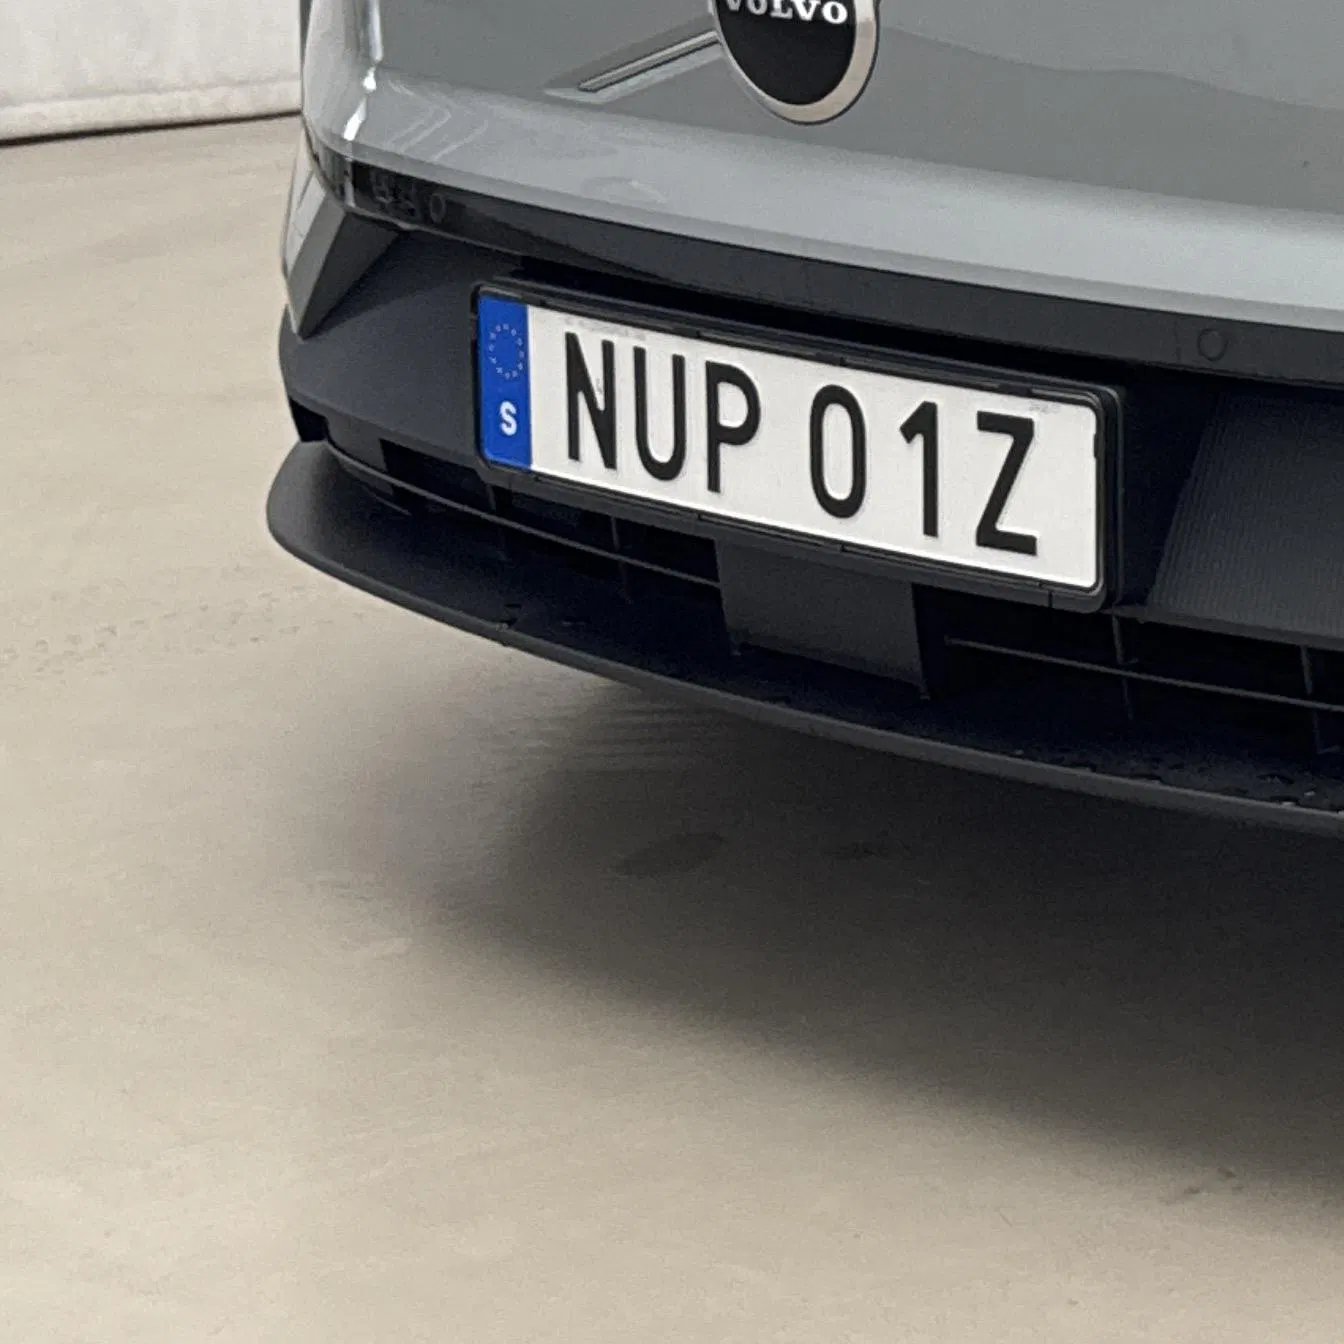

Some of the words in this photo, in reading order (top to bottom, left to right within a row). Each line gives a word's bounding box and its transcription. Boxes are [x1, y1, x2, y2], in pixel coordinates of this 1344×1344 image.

[499, 400, 518, 437] S
[564, 332, 762, 494] NUP
[809, 384, 1039, 558] 01Z
